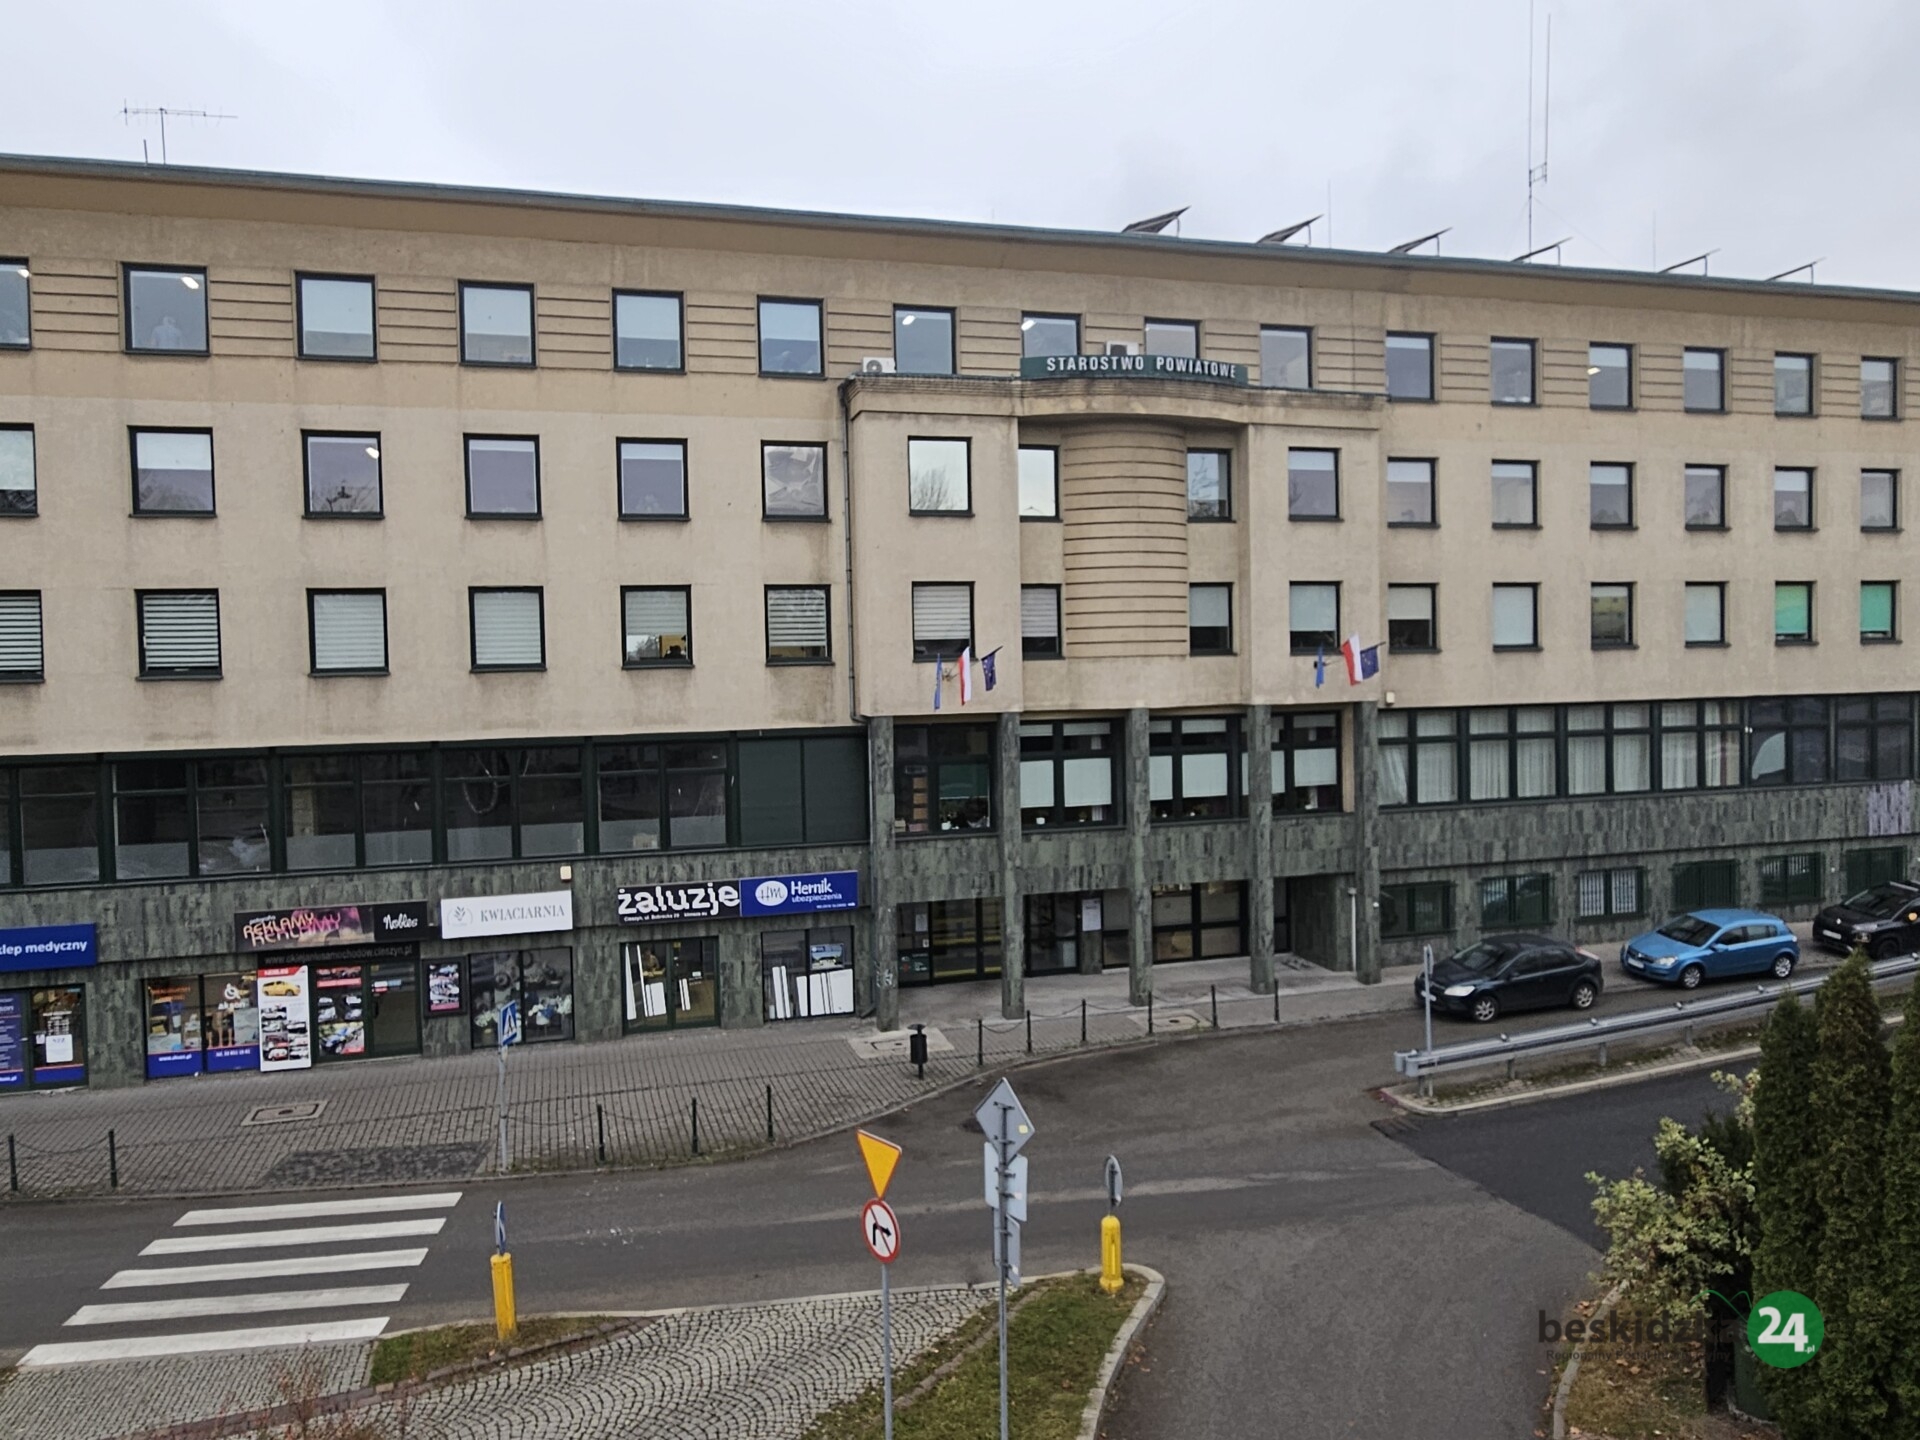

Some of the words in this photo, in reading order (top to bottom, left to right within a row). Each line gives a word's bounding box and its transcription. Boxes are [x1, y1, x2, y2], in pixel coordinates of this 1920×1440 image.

[1047, 356, 1144, 371] STAROSTWO
[1156, 356, 1236, 378] POWIATOWE
[791, 877, 833, 895] Hernik
[617, 882, 740, 915] żaluzje
[792, 893, 843, 903] ubezpieczenia
[383, 913, 418, 930] Nobles
[480, 905, 565, 922] KWIACIARNIA
[243, 912, 315, 940] REKLAMY
[0, 943, 22, 957] lep
[25, 941, 87, 954] medyczny
